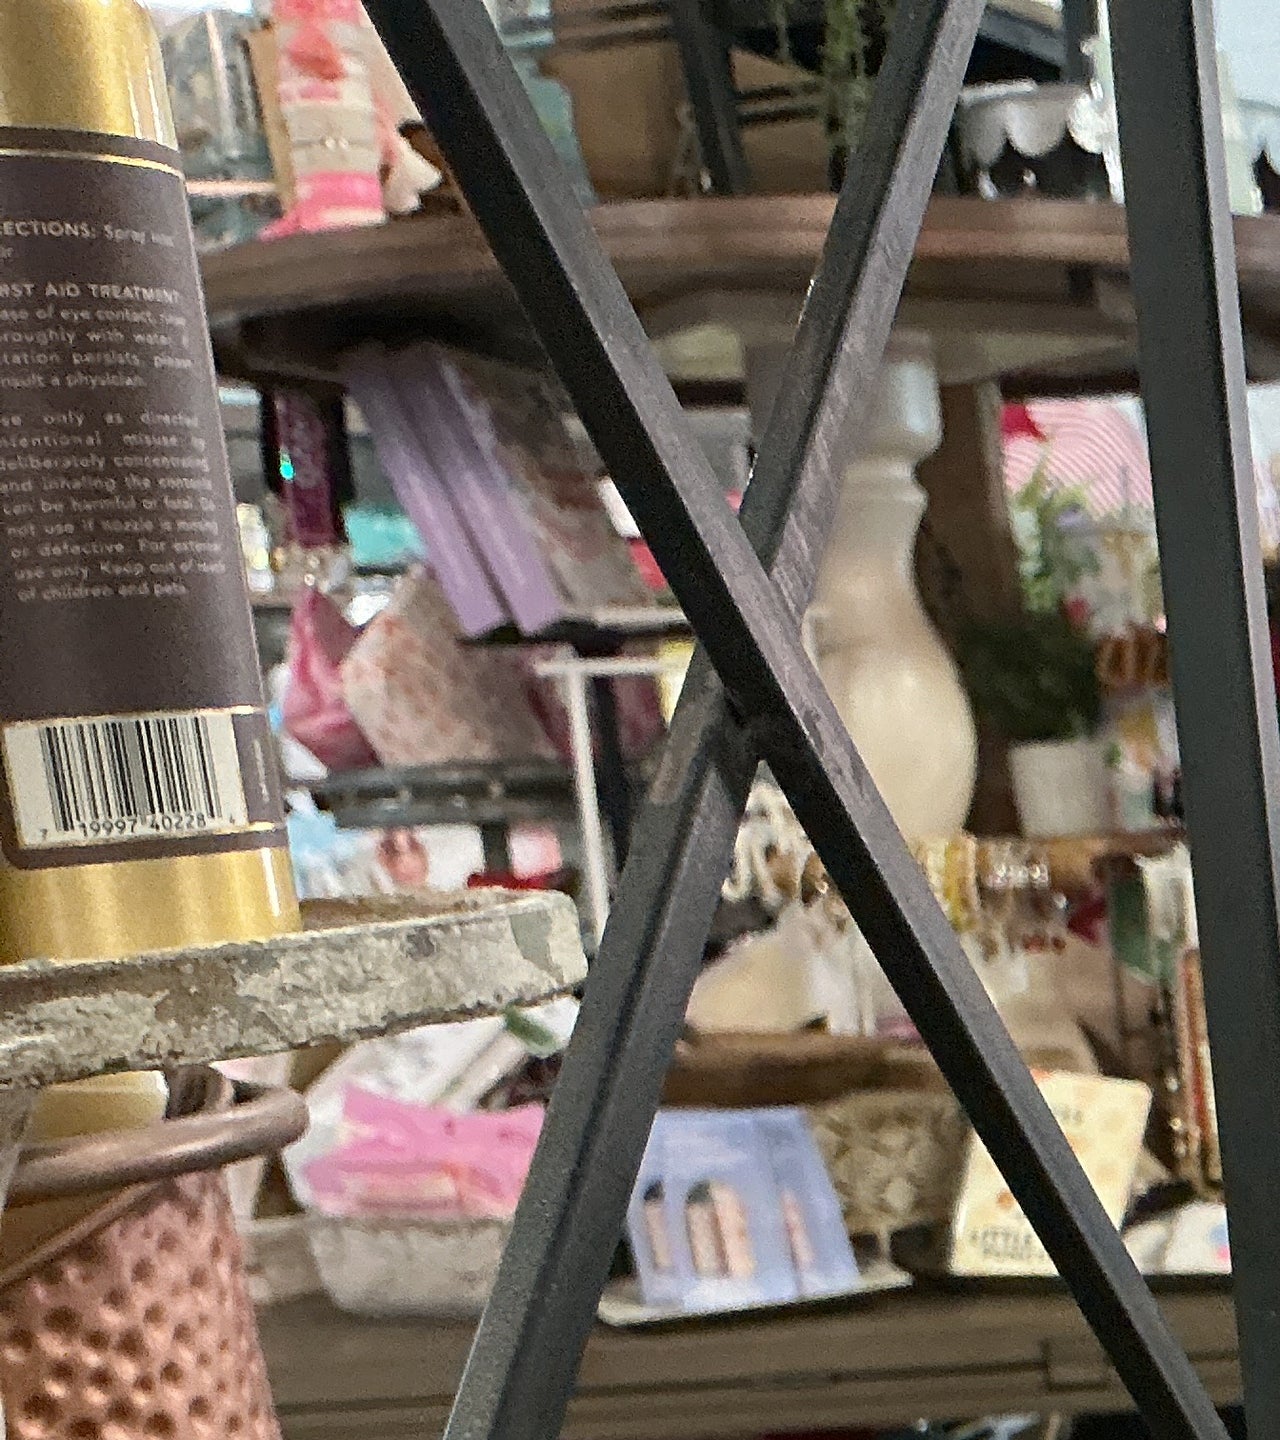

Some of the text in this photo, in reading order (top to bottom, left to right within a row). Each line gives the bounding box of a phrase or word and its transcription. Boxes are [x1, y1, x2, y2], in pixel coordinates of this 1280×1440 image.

[0, 220, 97, 239] ECTIONS:
[0, 284, 35, 298] RST
[45, 282, 81, 298] AID
[0, 328, 76, 346] roughly
[3, 351, 61, 366] tation
